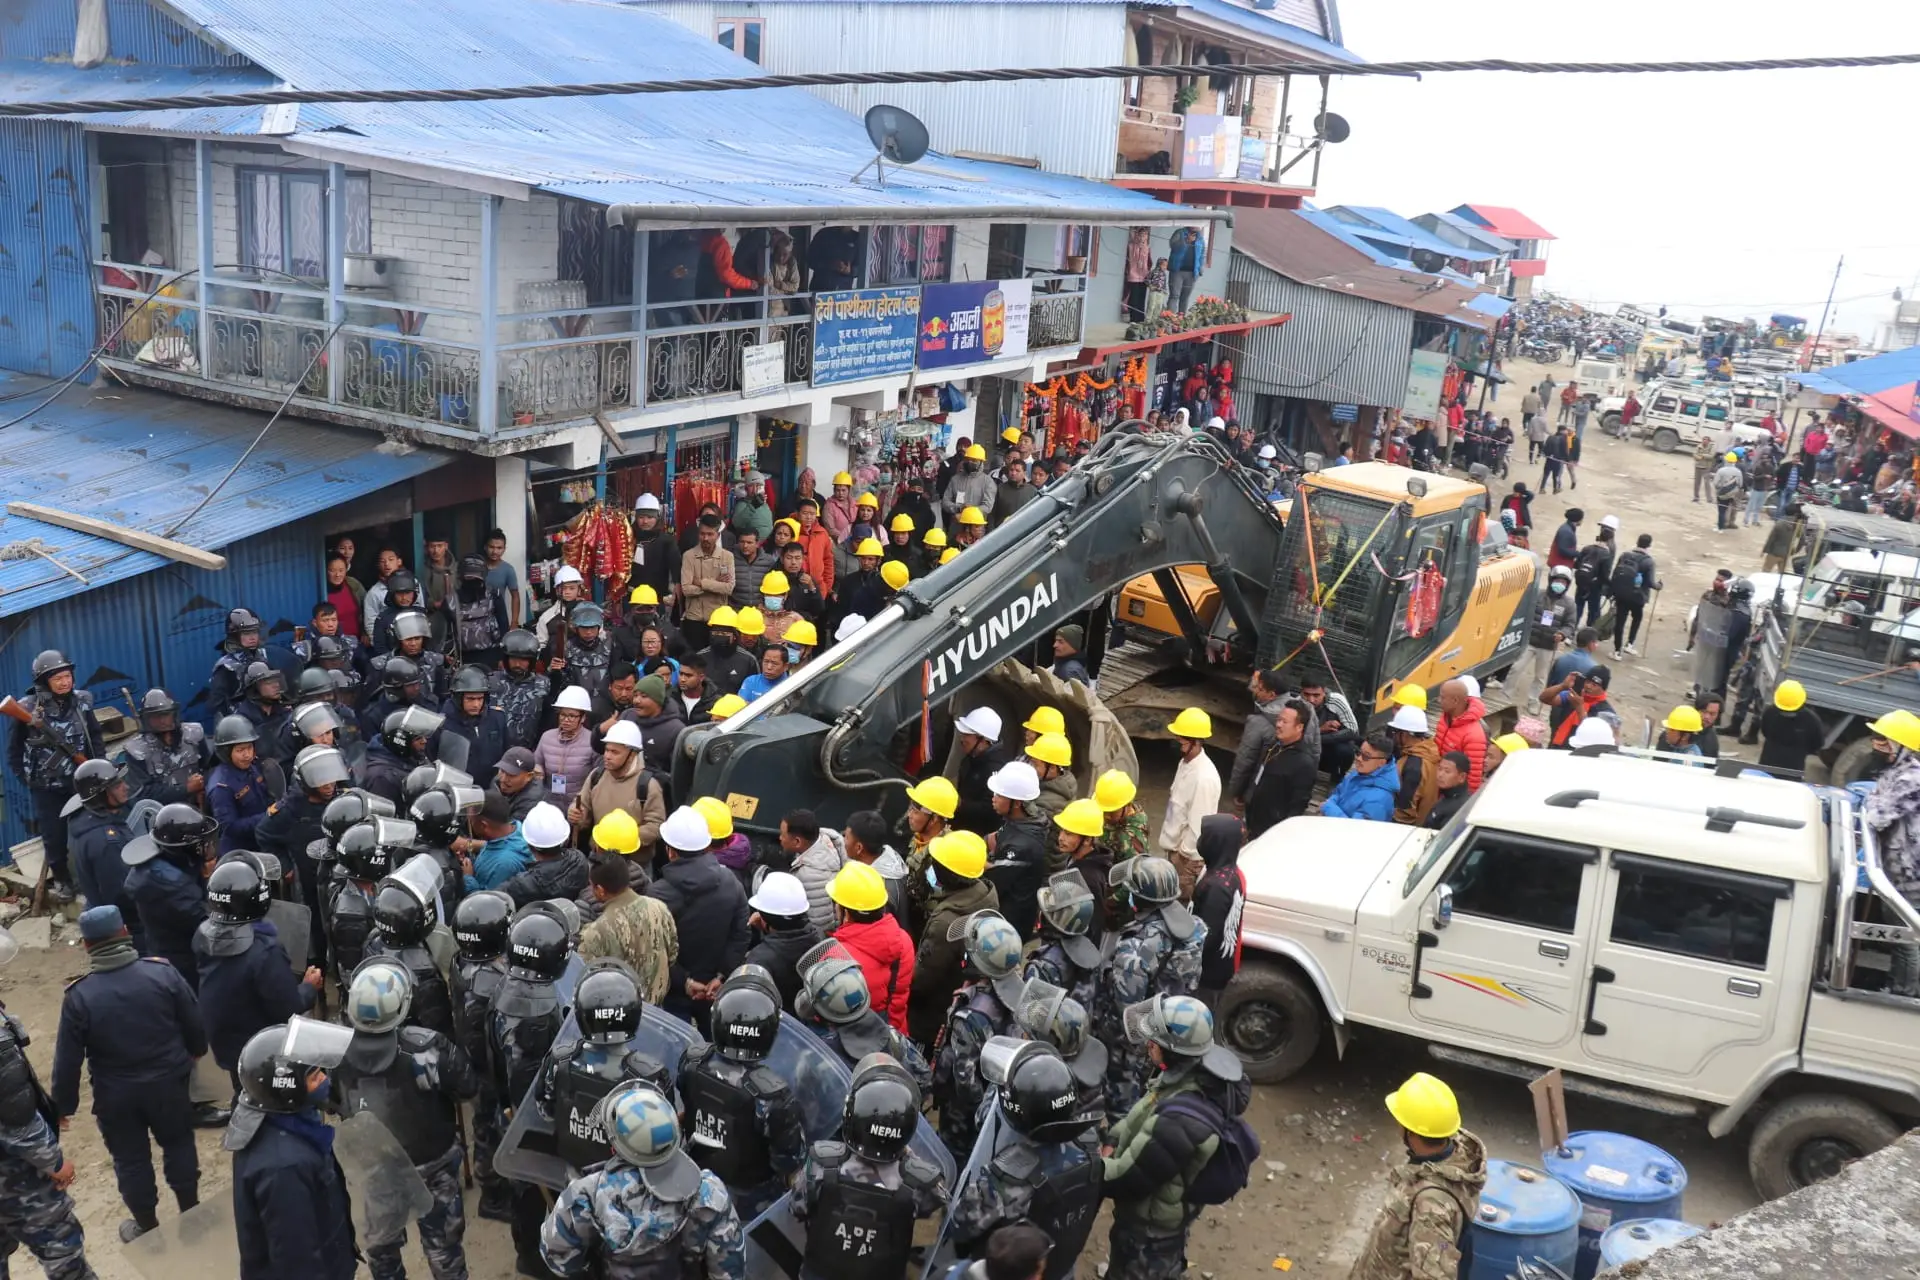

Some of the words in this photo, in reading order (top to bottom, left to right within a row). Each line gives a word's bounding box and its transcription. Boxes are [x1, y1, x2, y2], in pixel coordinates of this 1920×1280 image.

[815, 296, 834, 324] देवी
[950, 306, 981, 332] असली
[928, 572, 1059, 696] HYUNDAI
[208, 891, 231, 903] POLICE
[456, 932, 481, 942] NEPAL
[513, 944, 540, 958] NEPAL
[1362, 948, 1407, 963] BOLERO
[729, 1024, 760, 1037] NEPAL
[272, 1078, 296, 1089] NEPAL
[1051, 1091, 1076, 1111] NEPAL
[569, 1120, 606, 1145] NEPAL
[870, 1124, 902, 1139] NEPAL
